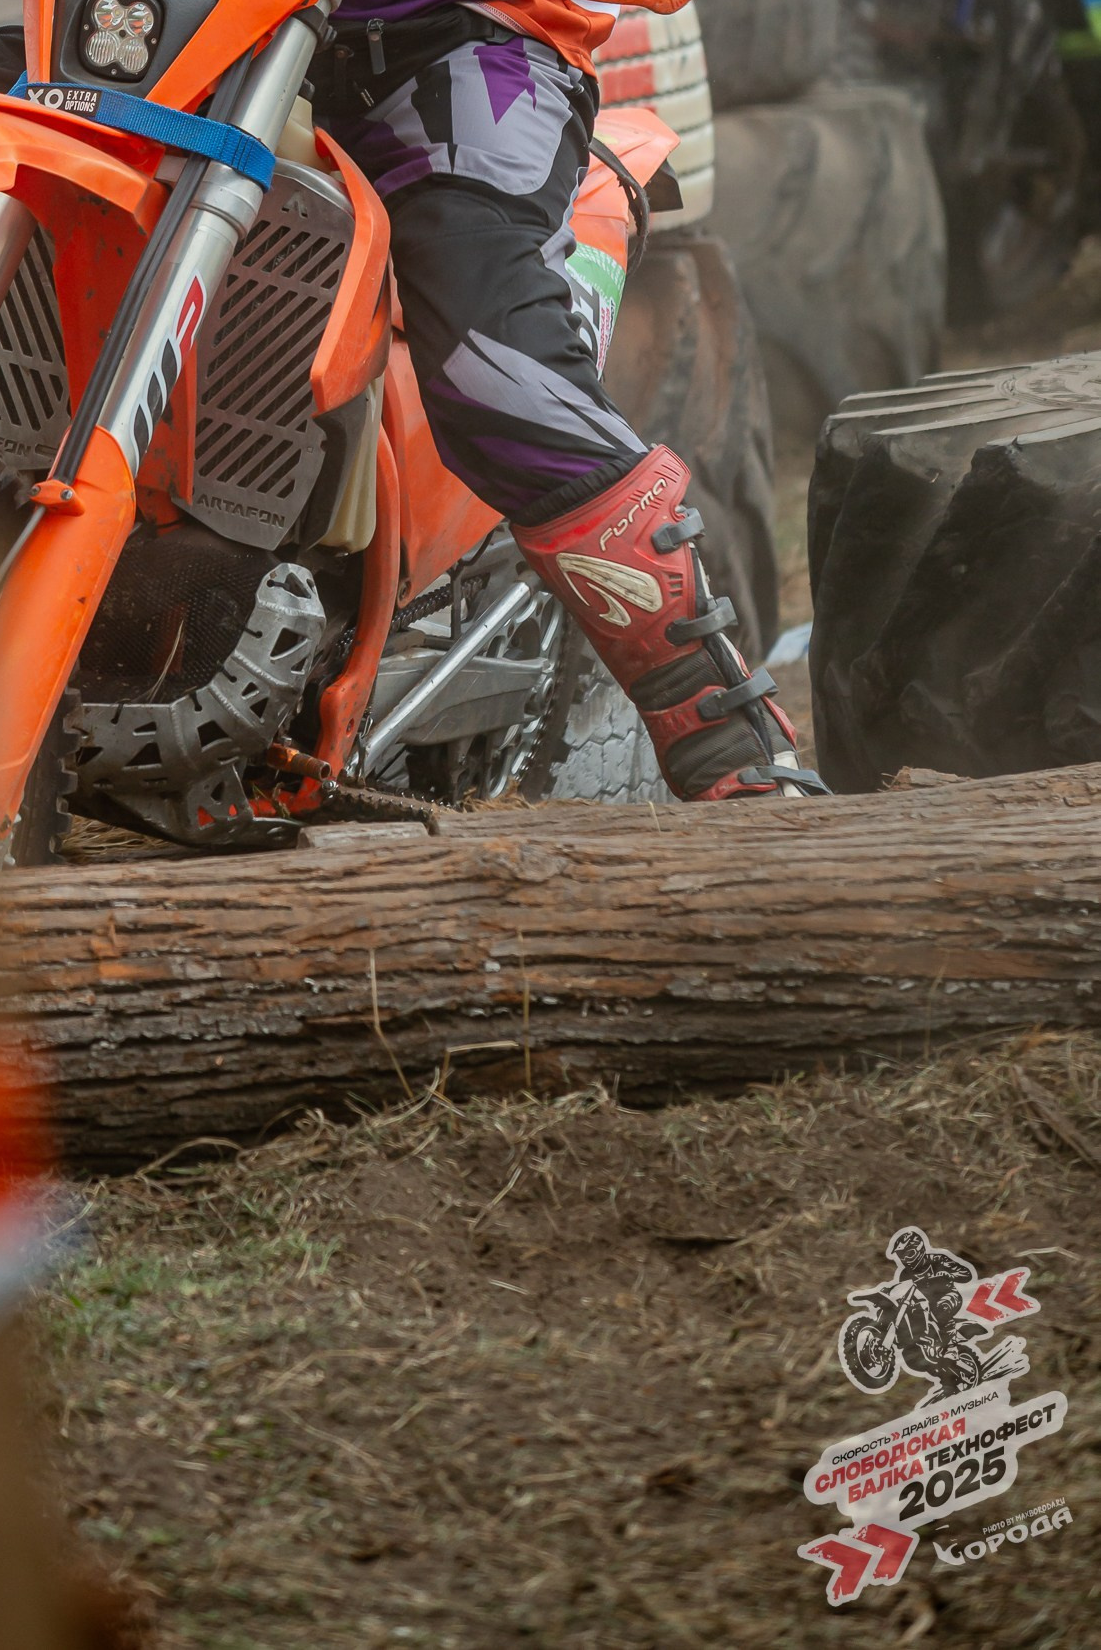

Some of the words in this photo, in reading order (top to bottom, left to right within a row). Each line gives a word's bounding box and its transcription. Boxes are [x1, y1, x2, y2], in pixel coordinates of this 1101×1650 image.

[27, 88, 64, 110] XO
[66, 90, 97, 103] EXTRA
[64, 101, 96, 113] OPTIONS
[196, 493, 286, 529] ARTAFON
